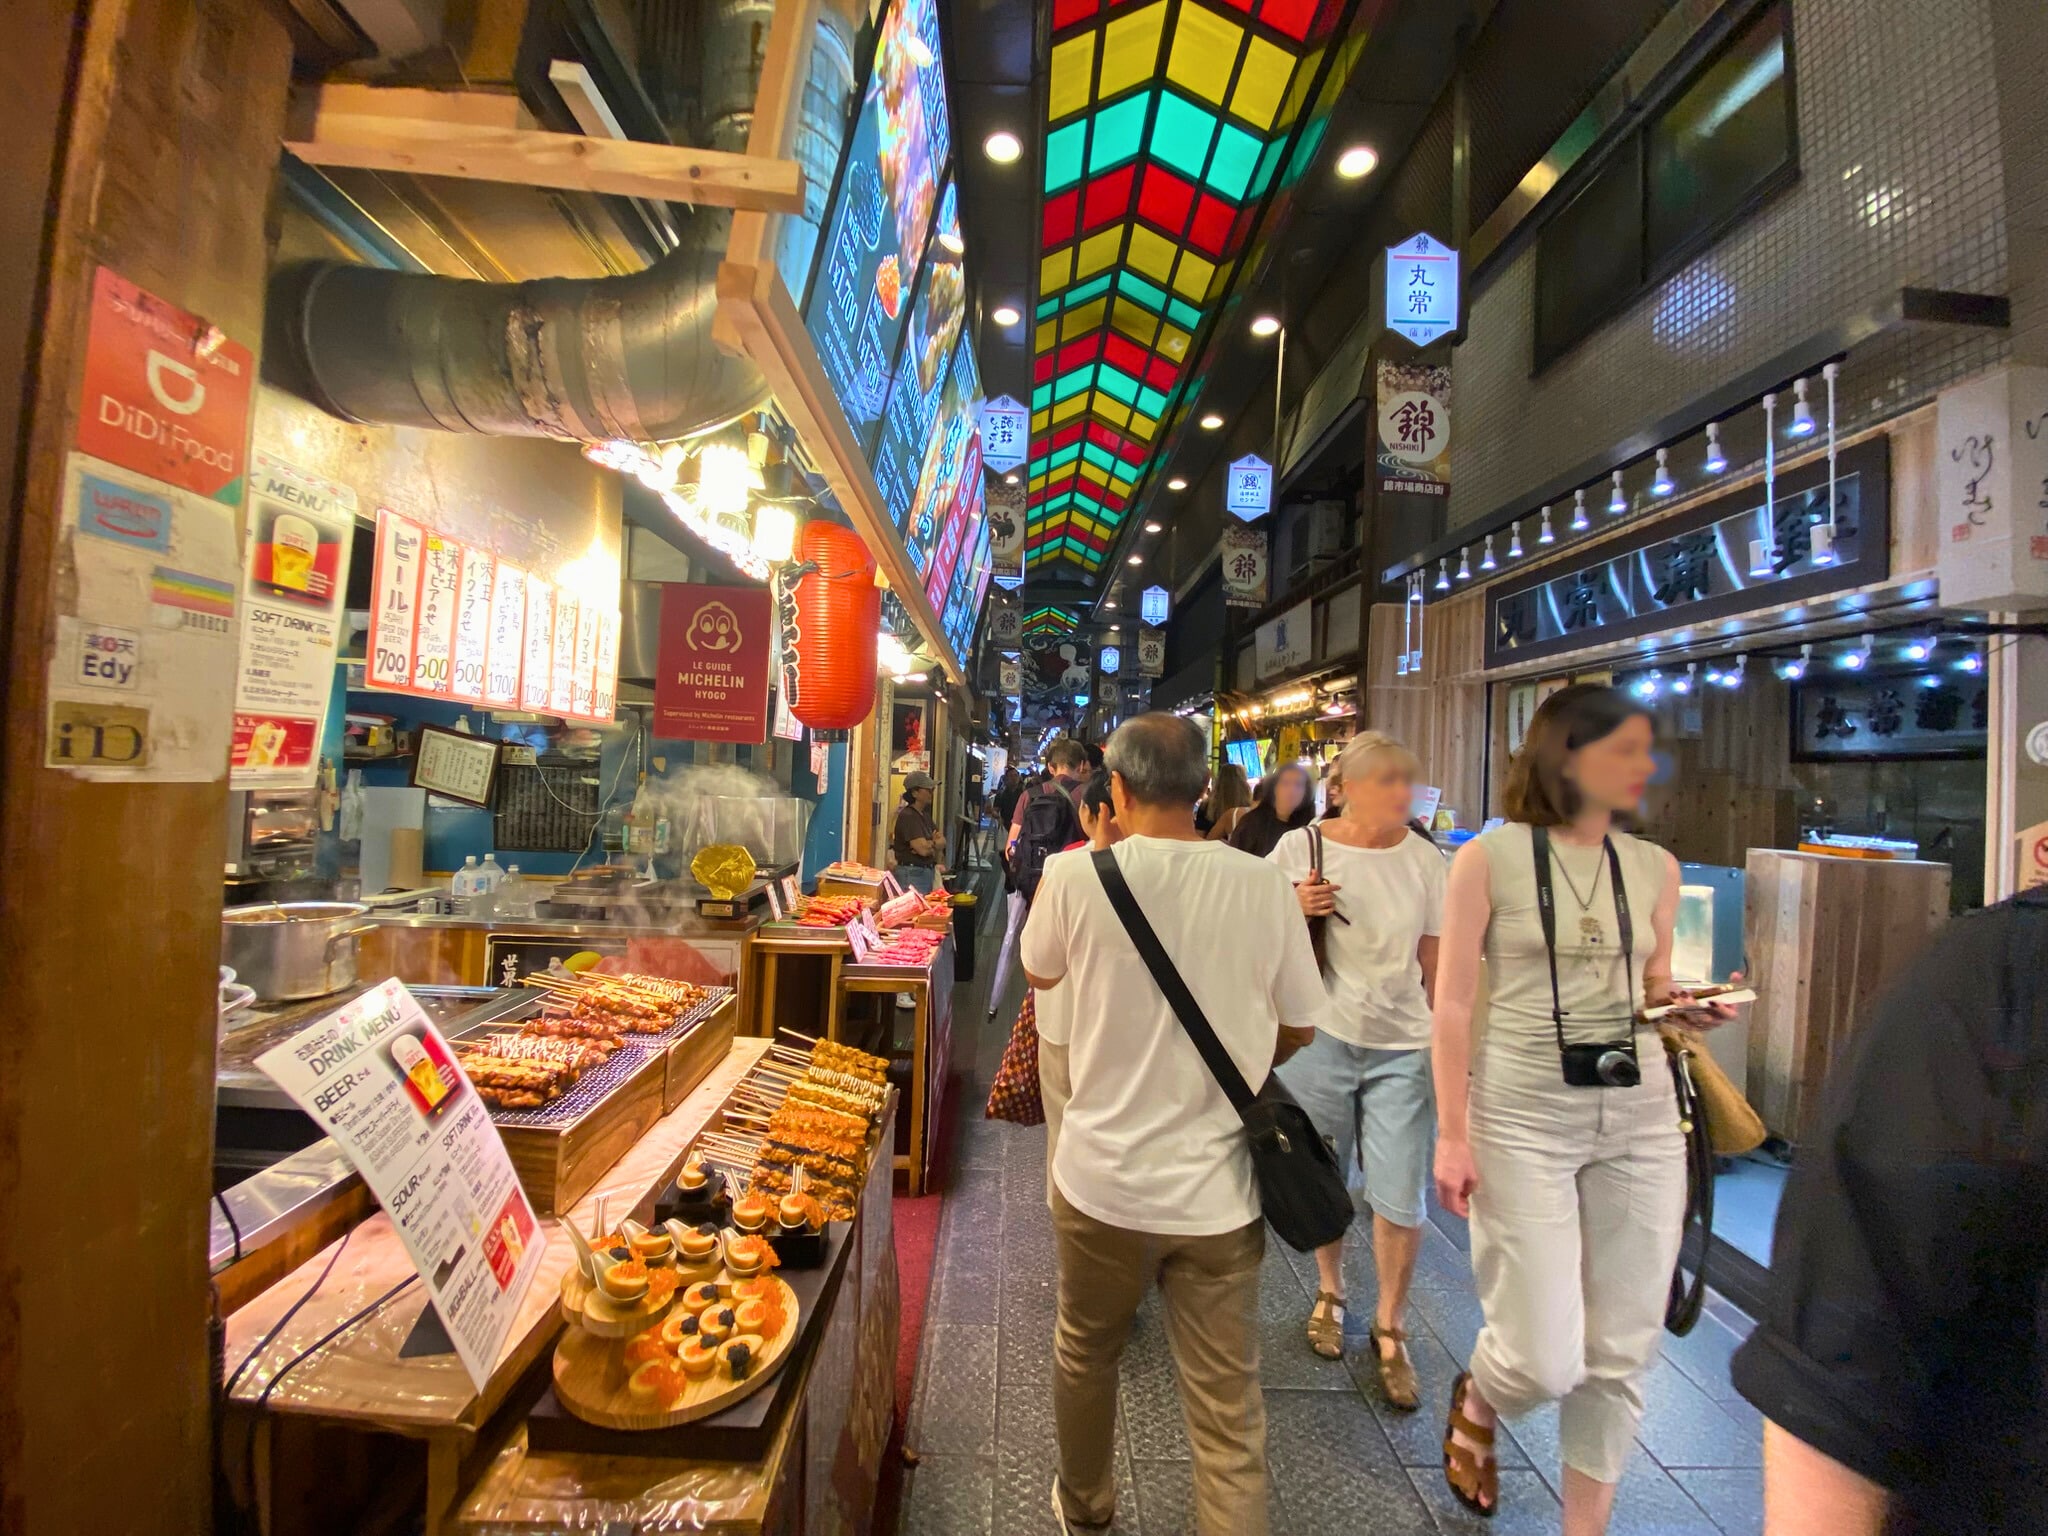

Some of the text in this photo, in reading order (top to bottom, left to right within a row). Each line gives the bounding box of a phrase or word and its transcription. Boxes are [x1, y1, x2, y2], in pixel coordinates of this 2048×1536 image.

[1408, 264, 1435, 315] 丸常
[903, 348, 923, 430] YAKITORI
[99, 394, 234, 473] DiDi Food
[1389, 400, 1435, 455] 錦
[1389, 442, 1420, 452] NISHIKI
[265, 478, 326, 513] MENU
[1383, 479, 1445, 496] 錦市場商店街
[389, 531, 418, 614] ビール
[1229, 553, 1257, 585] 錦
[460, 560, 478, 632] イクラのせ
[251, 609, 283, 627] SOFT
[283, 616, 314, 634] DRINK
[83, 654, 134, 684] Edy
[377, 648, 407, 674] 700
[415, 654, 450, 681] 500
[455, 659, 485, 684] 500
[692, 661, 732, 672] LE GUIDE
[487, 671, 517, 697] 1700
[524, 683, 550, 706] 1700
[677, 672, 745, 689] MICHELIN
[695, 690, 727, 701] HYOGO
[60, 722, 144, 762] iD
[500, 953, 519, 988] 世界
[308, 1007, 401, 1077] DRINK MENU
[313, 1073, 358, 1113] BEER
[391, 1173, 420, 1215] SOUR
